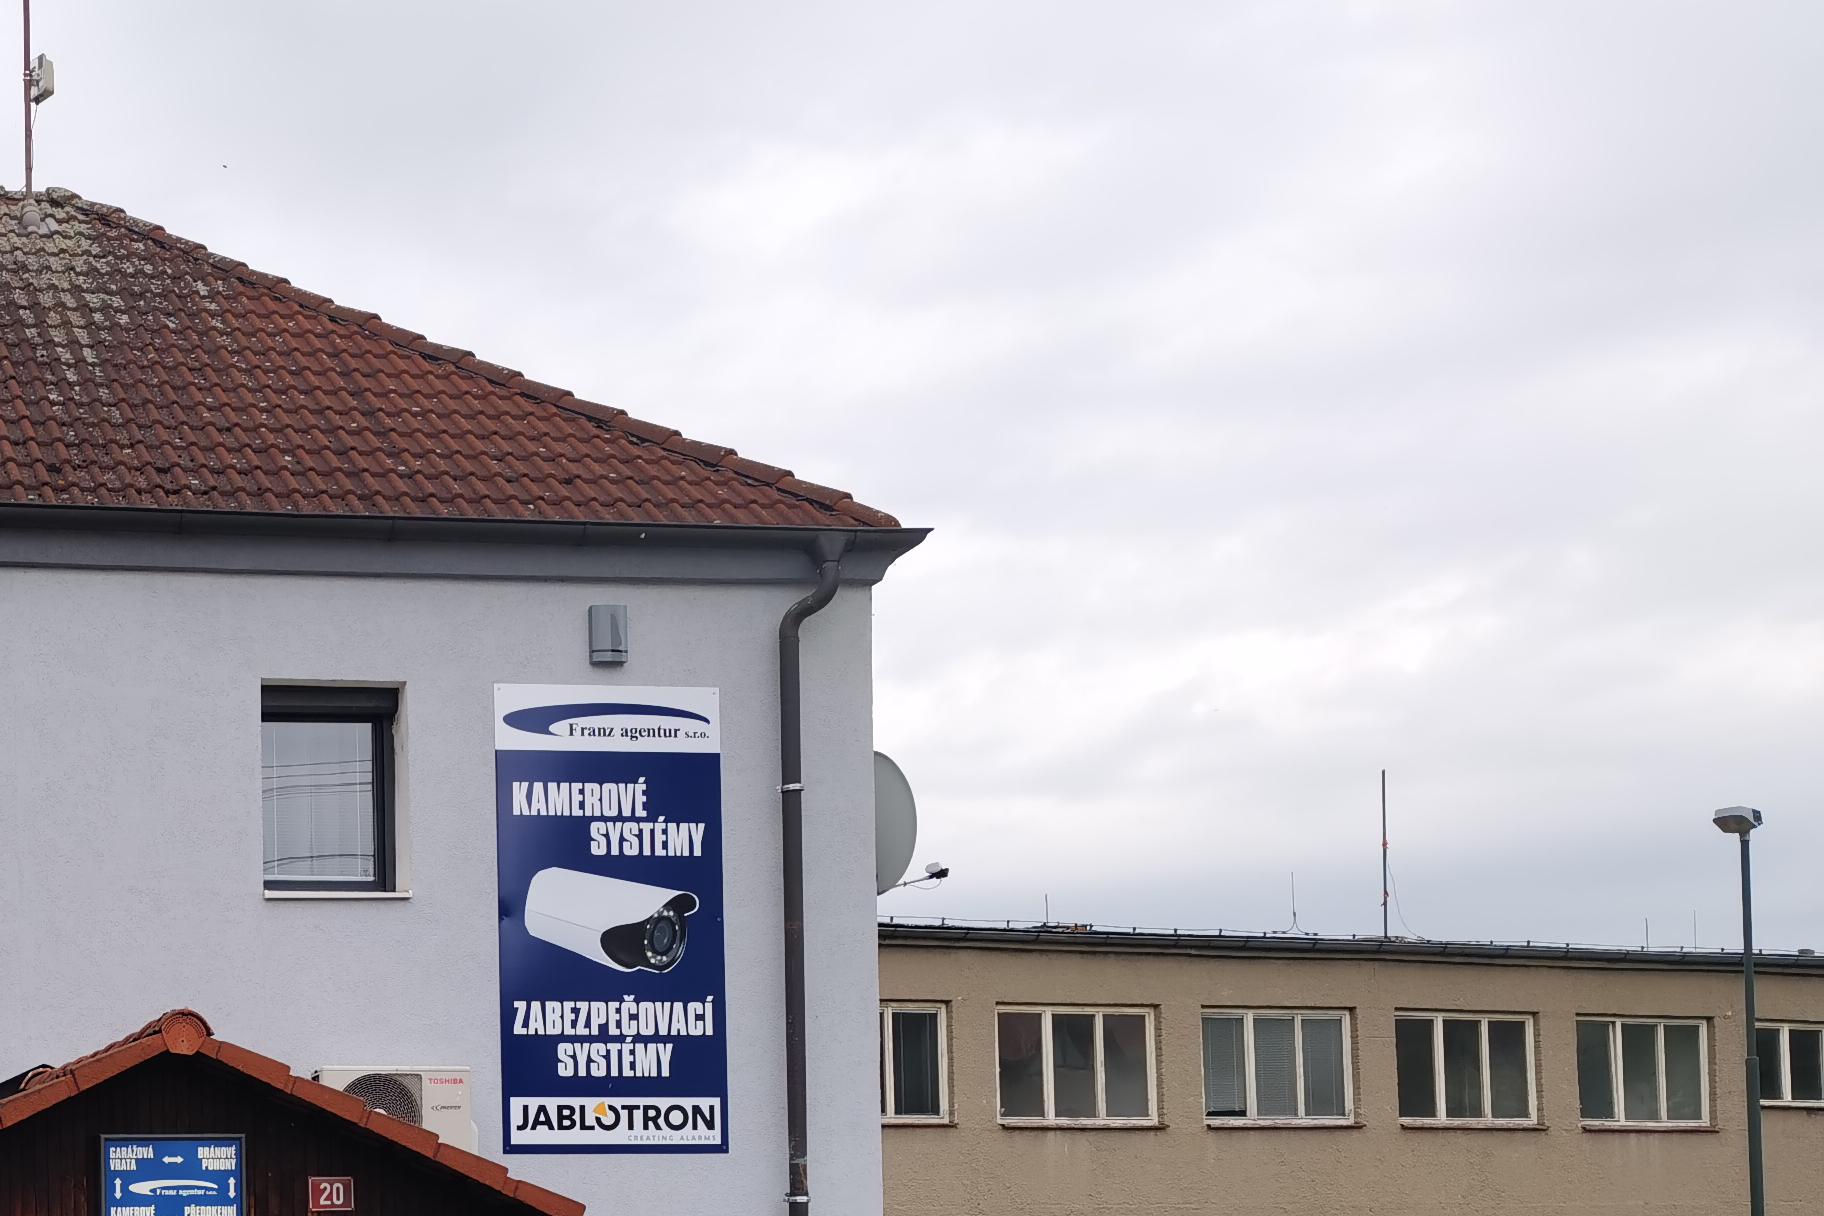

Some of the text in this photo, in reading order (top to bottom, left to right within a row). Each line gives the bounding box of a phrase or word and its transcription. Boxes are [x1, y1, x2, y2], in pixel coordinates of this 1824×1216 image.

[568, 722, 710, 741] Franz agentur s.r.o.
[512, 776, 648, 817] KAMEROVÉ
[590, 815, 706, 857] SYSTÉMY
[513, 994, 714, 1036] ZABEZPEČOVACÍ
[557, 1036, 674, 1077] SYSTÉMY
[428, 1077, 464, 1085] TOSHIBA
[516, 1102, 716, 1132] JABLOTRON
[627, 1134, 717, 1142] CREATING ALARMS
[109, 1145, 154, 1159] GARÁŽOVÁ
[197, 1145, 236, 1159] BRÁNOVÉ
[110, 1158, 137, 1171] VRATA
[201, 1158, 236, 1171] POHONY
[319, 1181, 344, 1205] 20
